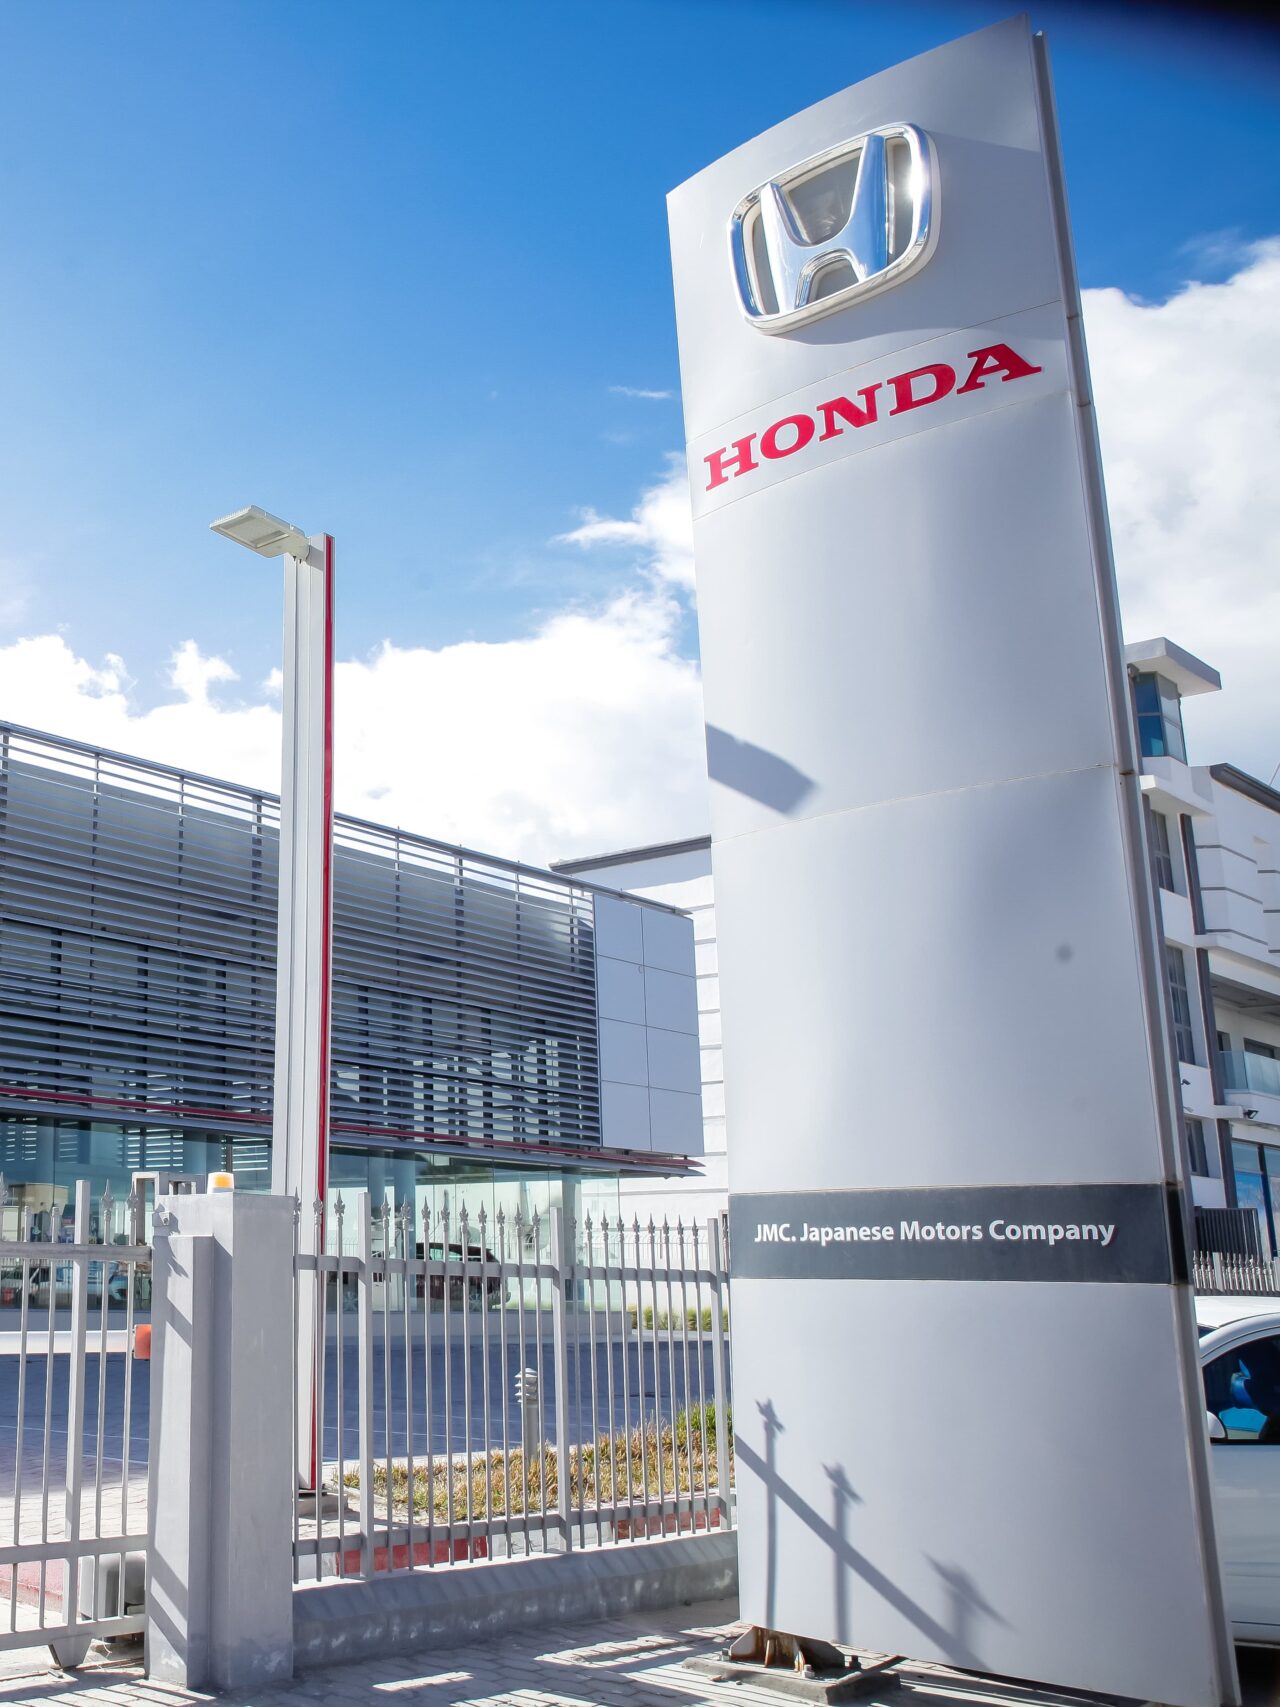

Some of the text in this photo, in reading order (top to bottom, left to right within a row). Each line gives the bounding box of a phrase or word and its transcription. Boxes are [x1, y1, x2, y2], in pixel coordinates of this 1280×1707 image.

[703, 343, 1042, 492] HONDA
[754, 1219, 1115, 1246] JMC. Japanese Motors Company
